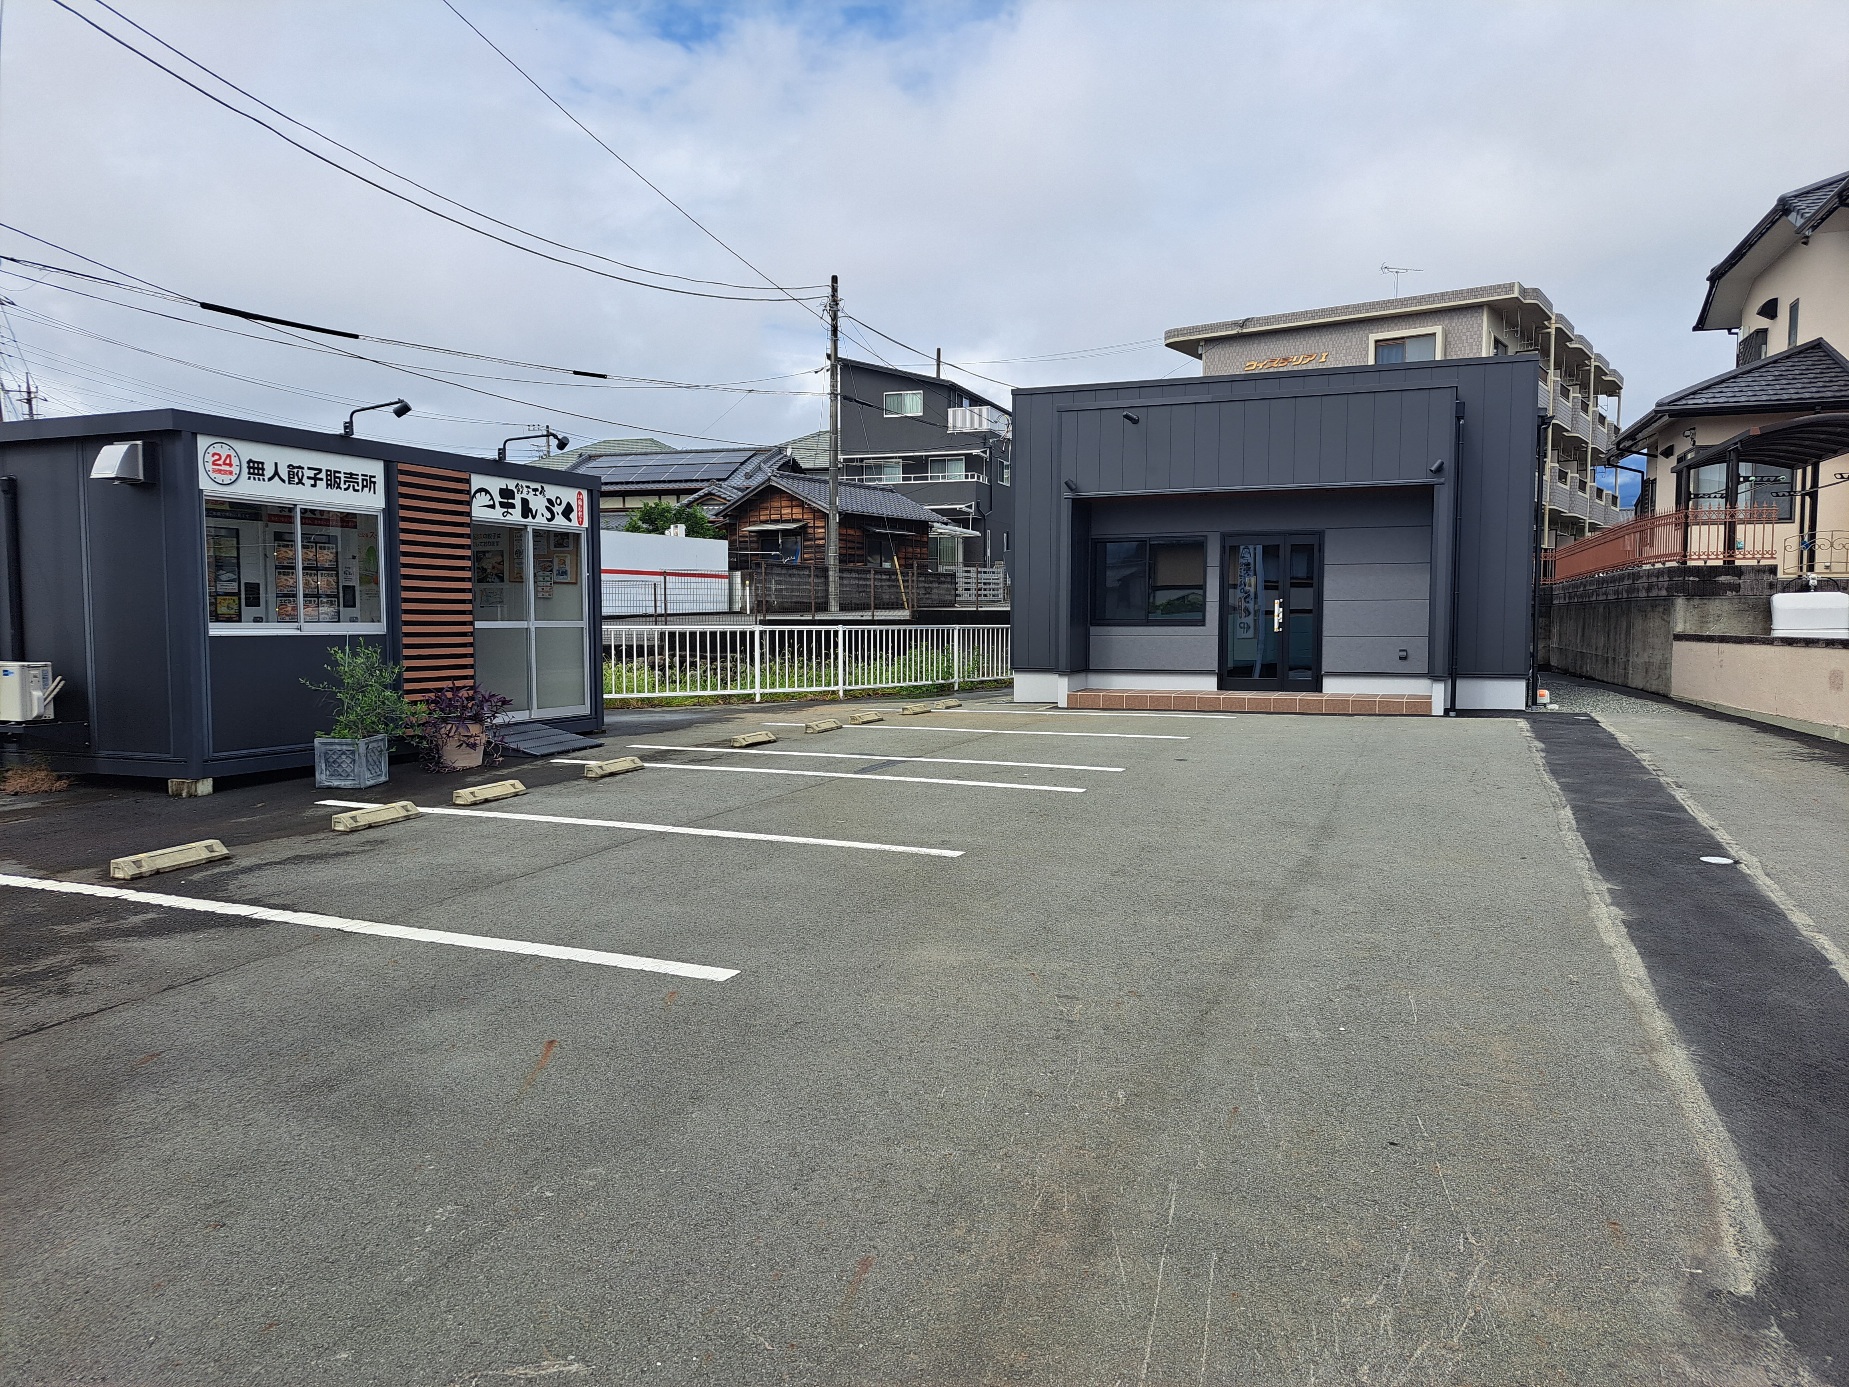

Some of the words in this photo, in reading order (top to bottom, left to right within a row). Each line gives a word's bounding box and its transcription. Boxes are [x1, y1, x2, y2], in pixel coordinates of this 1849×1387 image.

[211, 452, 233, 468] 24
[246, 458, 377, 495] 無人餃子販売所
[498, 483, 575, 523] まんぷく
[514, 482, 547, 498] 餃子工房
